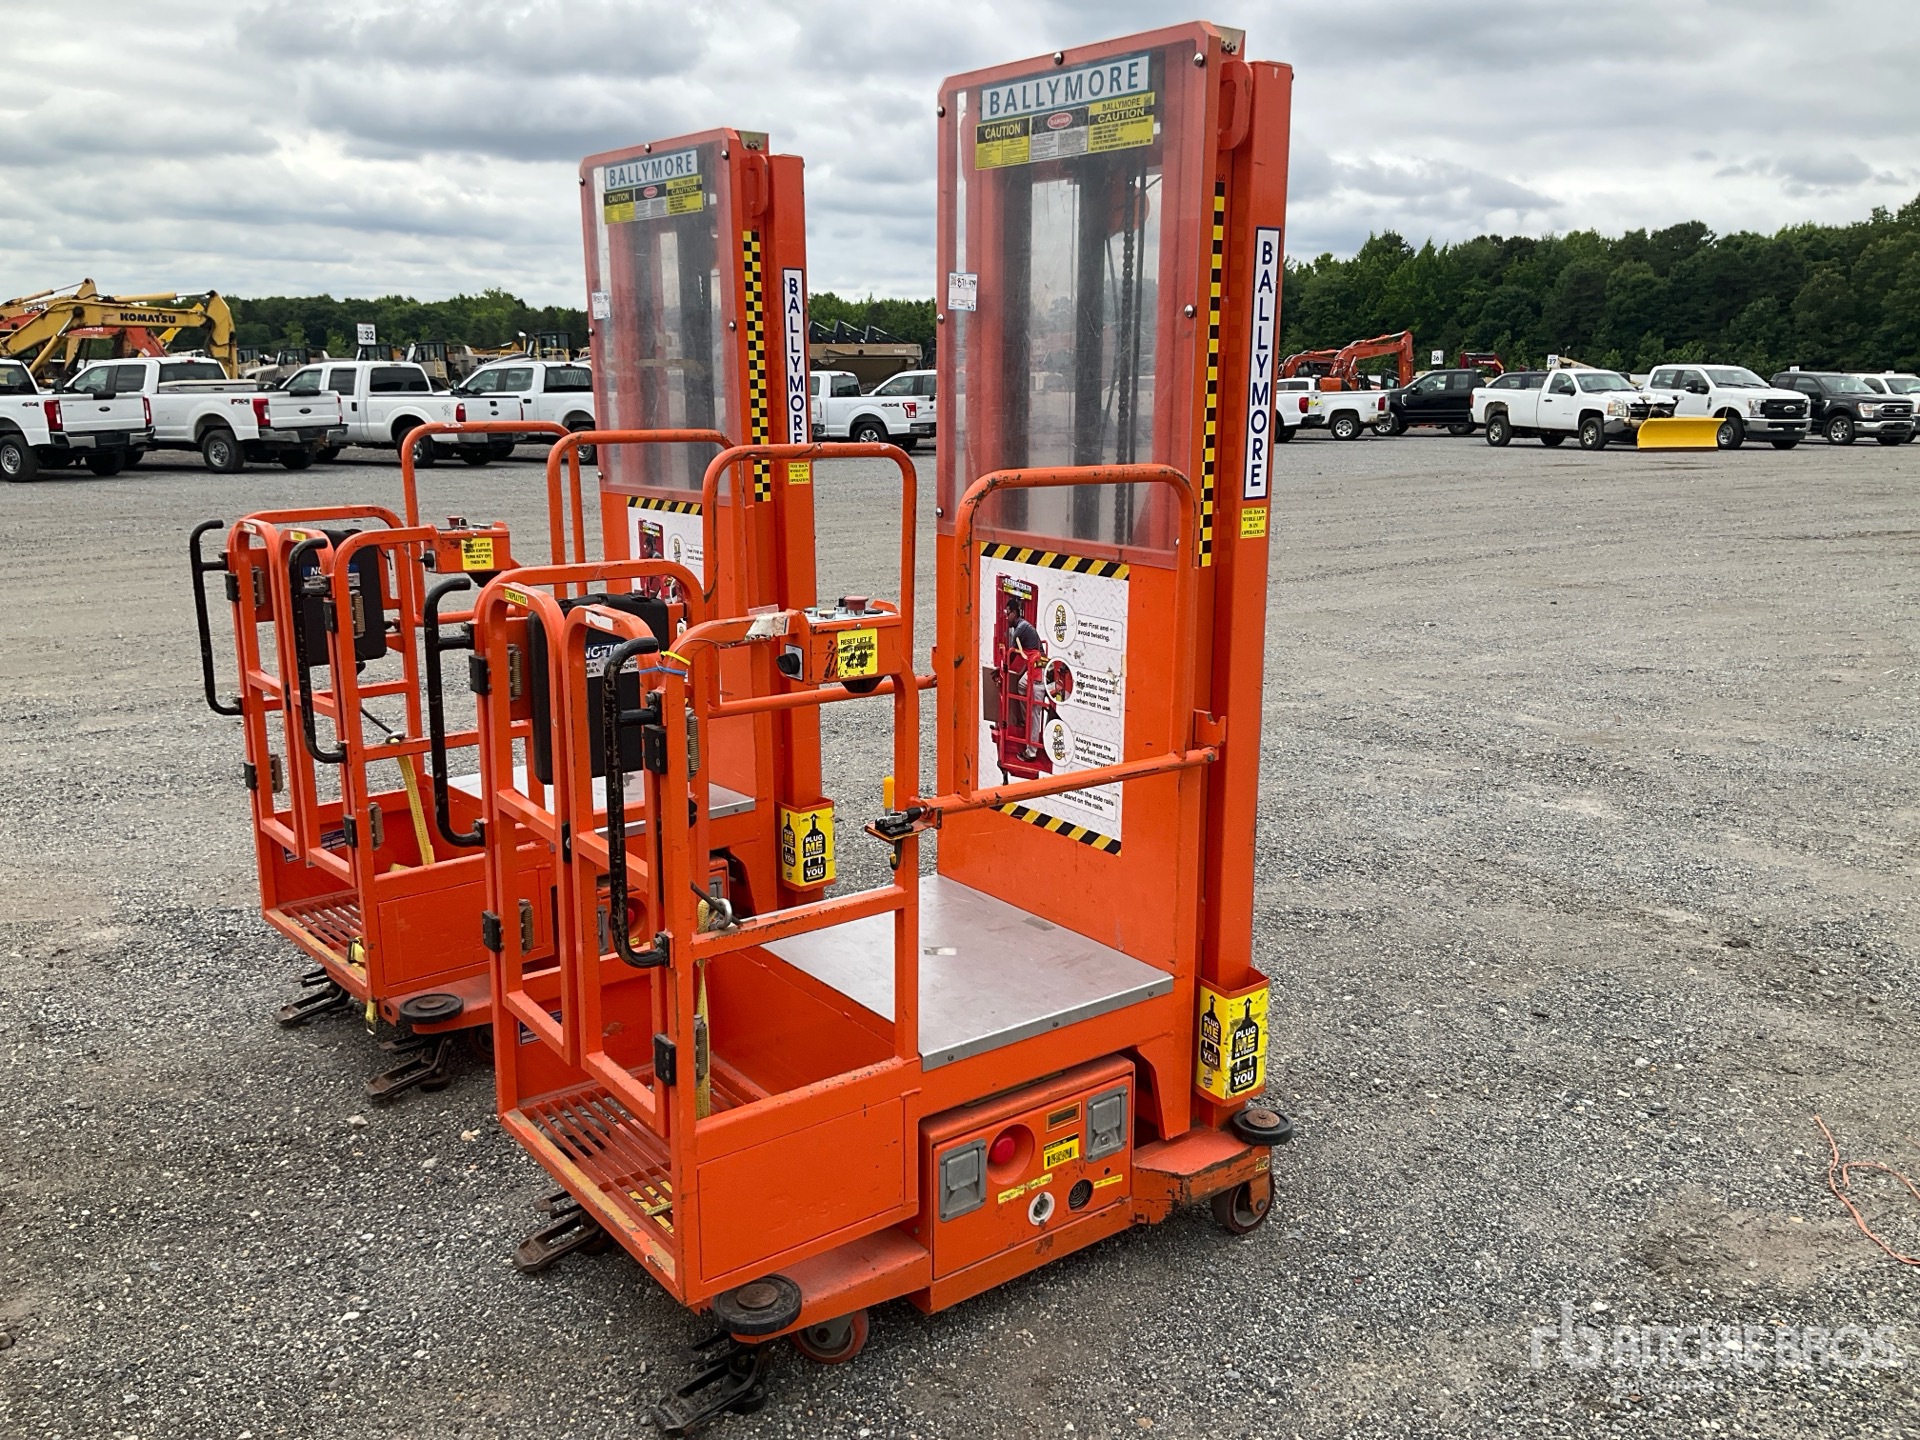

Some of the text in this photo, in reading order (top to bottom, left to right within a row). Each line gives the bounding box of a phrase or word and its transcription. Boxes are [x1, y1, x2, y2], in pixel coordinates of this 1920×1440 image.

[990, 62, 1139, 116] BALLYMORE
[1102, 97, 1140, 112] BALLYMORE
[1098, 107, 1145, 123] CAUTION
[985, 122, 1021, 140] CAUTION
[609, 154, 692, 187] BALLYMORE
[671, 185, 697, 195] CAUTION
[608, 192, 630, 203] CAUTION
[120, 312, 176, 324] KOMATSU
[364, 330, 375, 341] 32
[788, 277, 805, 445] BALLYMORE
[1250, 241, 1273, 487] BALLYMORE
[1433, 354, 1440, 362] 36
[1089, 622, 1099, 630] First
[840, 637, 856, 646] RESET
[856, 636, 868, 644] LIFT
[1076, 671, 1089, 679] Place
[1097, 676, 1109, 685] body
[1083, 690, 1097, 699] yellow
[1076, 736, 1111, 752] Always wear the
[1075, 745, 1116, 762] body belt attached
[1081, 756, 1092, 764] static
[1064, 793, 1077, 802] stand
[1084, 799, 1092, 807] the
[1093, 794, 1103, 803] side
[805, 834, 823, 843] PLUG
[805, 840, 823, 852] ME
[784, 852, 795, 863] YOU
[806, 866, 823, 877] YOU
[1203, 1015, 1219, 1029] PLUG
[1203, 1022, 1219, 1038] ME
[1235, 1025, 1256, 1040] PLUG
[1235, 1033, 1256, 1053] ME
[1203, 1050, 1218, 1066] YOU
[1240, 1046, 1255, 1056] TODAY
[1233, 1070, 1254, 1086] YOU
